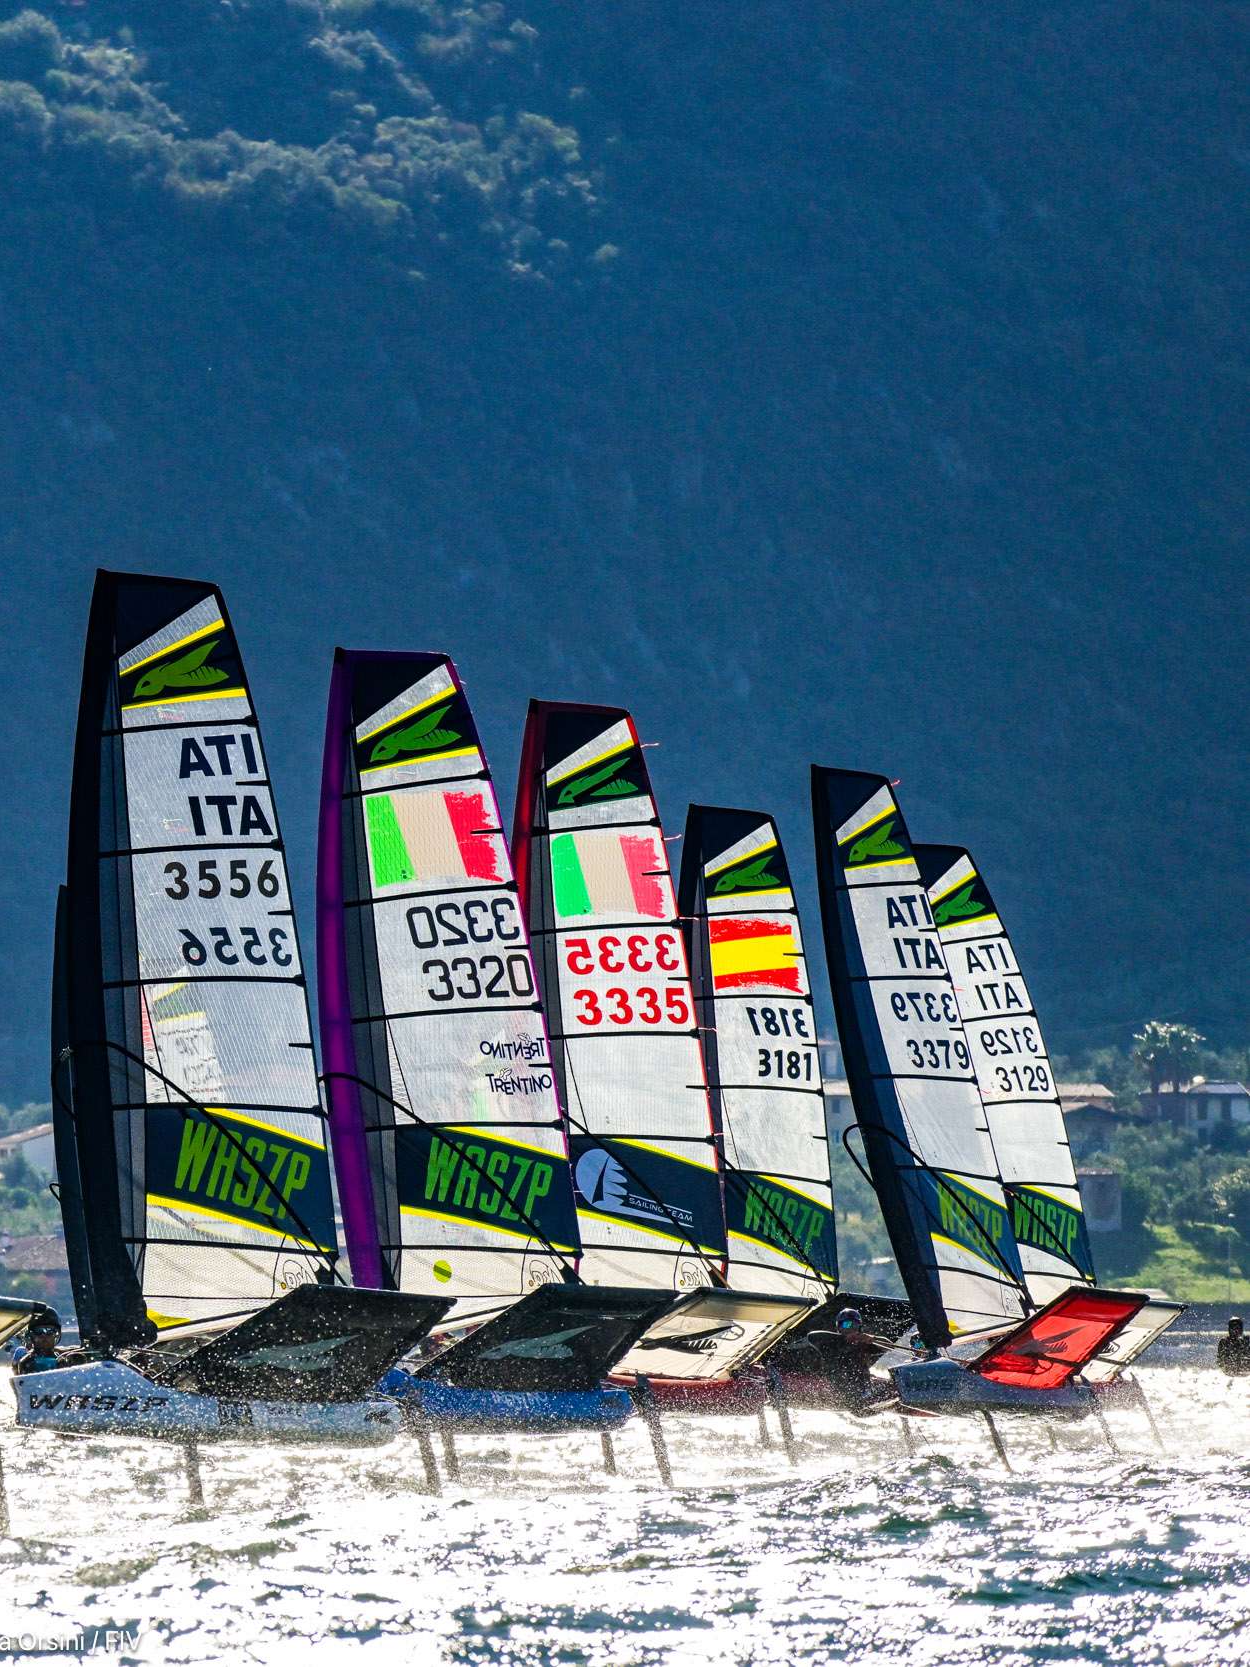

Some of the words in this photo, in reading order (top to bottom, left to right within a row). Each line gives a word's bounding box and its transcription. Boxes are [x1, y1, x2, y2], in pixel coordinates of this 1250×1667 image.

[188, 795, 274, 837] ITA
[163, 859, 280, 901] 3556
[893, 937, 945, 970] ITA
[422, 953, 535, 1002] 3320
[573, 987, 690, 1026] 3335
[974, 982, 1023, 1011] ITA
[758, 1048, 813, 1082] 3181
[906, 1039, 971, 1071] 3379
[485, 1073, 553, 1096] TRENTINO
[994, 1065, 1050, 1093] 3129
[174, 1117, 311, 1220] WASZP
[425, 1136, 553, 1225] WASZP
[628, 1197, 664, 1214] SAILING
